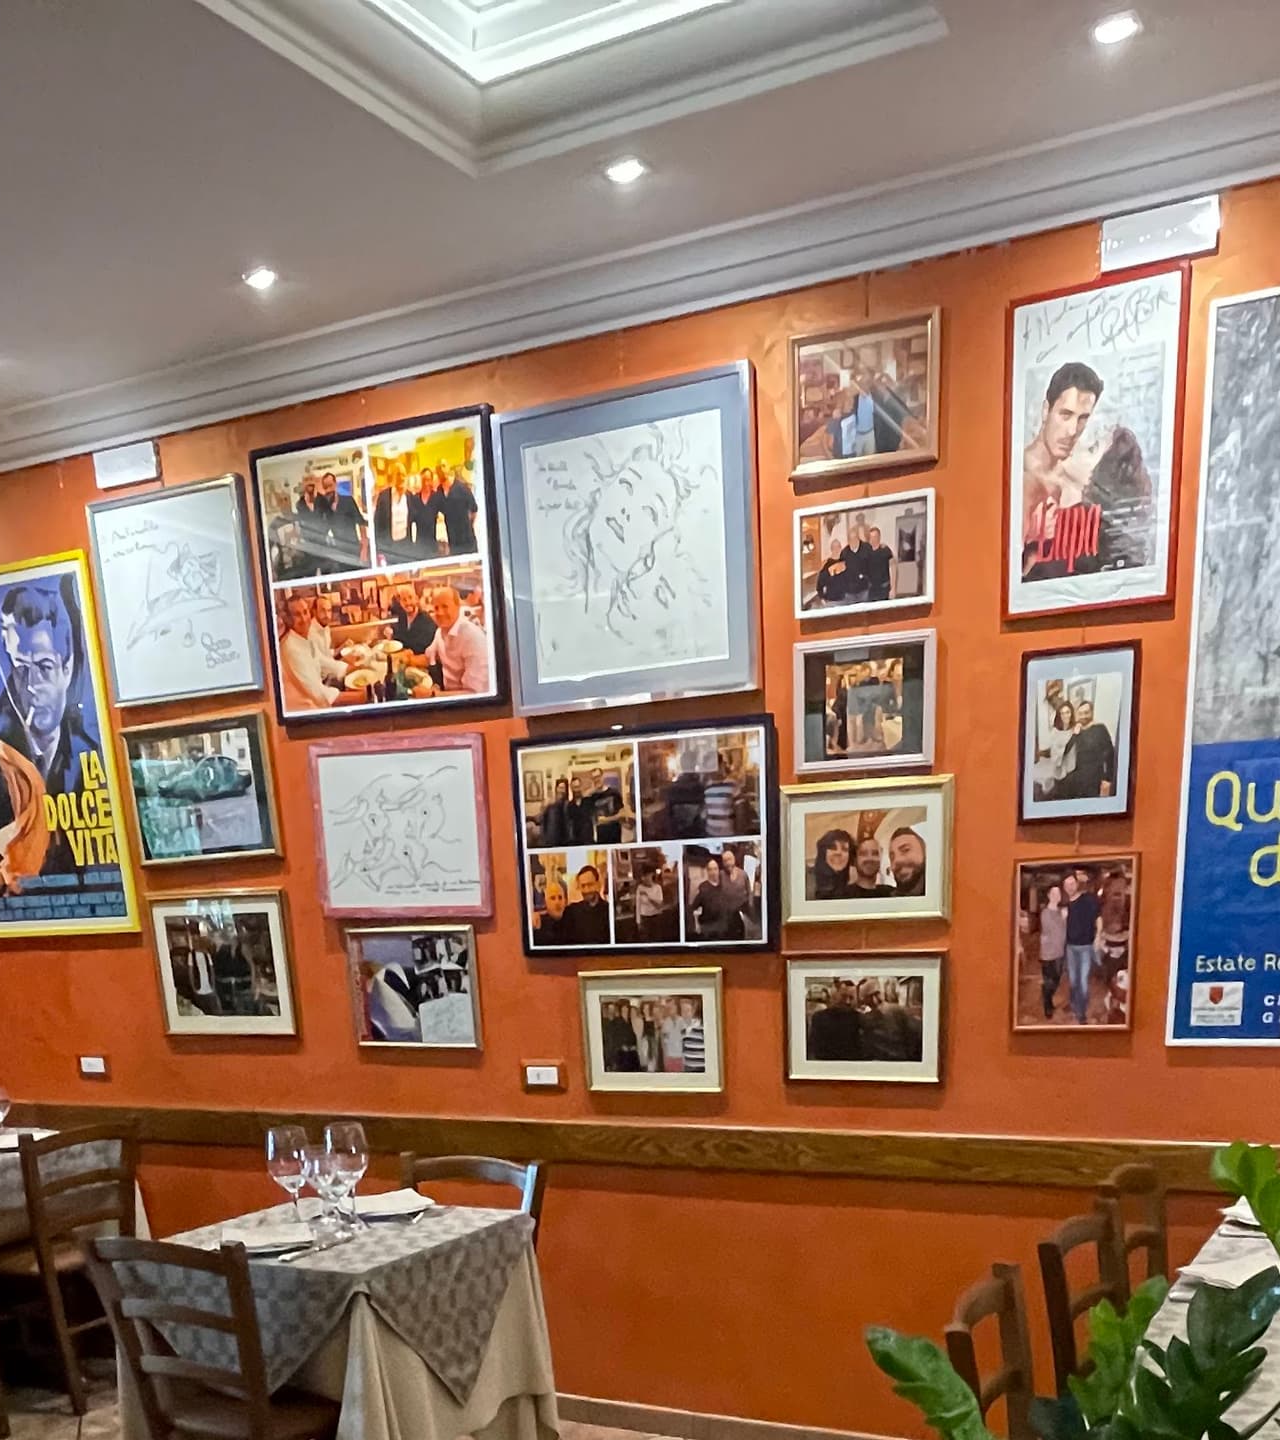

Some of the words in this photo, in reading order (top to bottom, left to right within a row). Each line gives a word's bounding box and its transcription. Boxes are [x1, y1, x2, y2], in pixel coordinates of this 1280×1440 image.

[79, 750, 107, 790] LA
[42, 788, 114, 832] DOLCE
[65, 826, 120, 867] VITA
[1195, 953, 1256, 974] Estate
